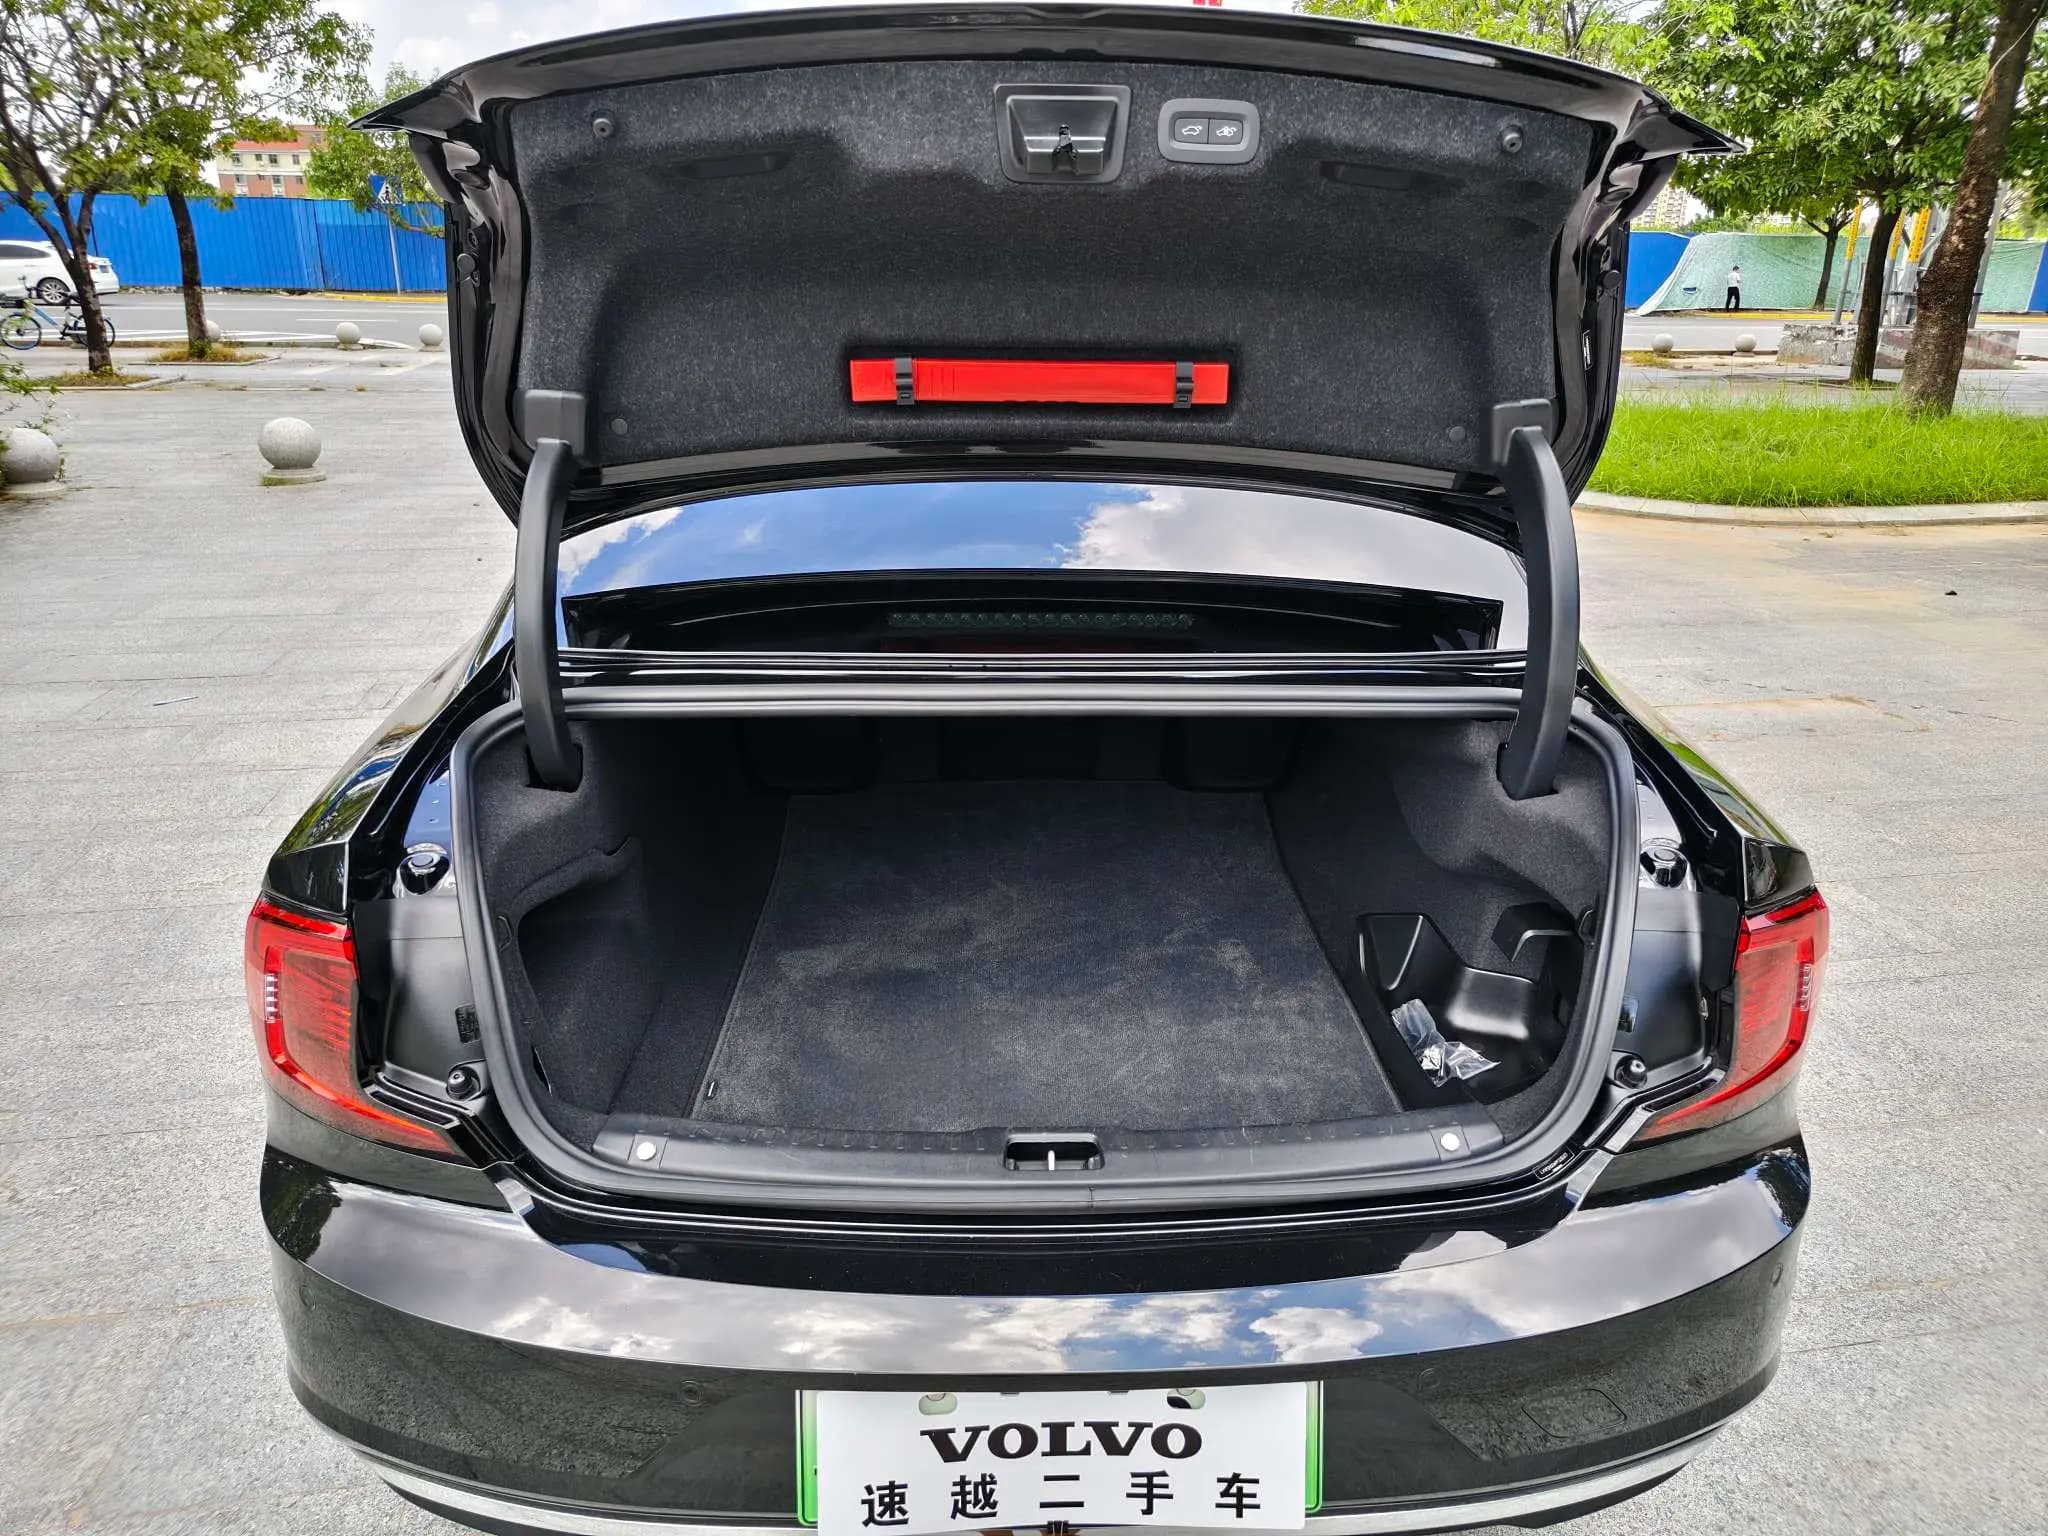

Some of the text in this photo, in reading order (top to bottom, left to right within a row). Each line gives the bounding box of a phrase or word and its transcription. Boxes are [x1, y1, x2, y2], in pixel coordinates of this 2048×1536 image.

[920, 1422, 1202, 1463] VOLVO
[861, 1471, 1261, 1527] 速越二手车
